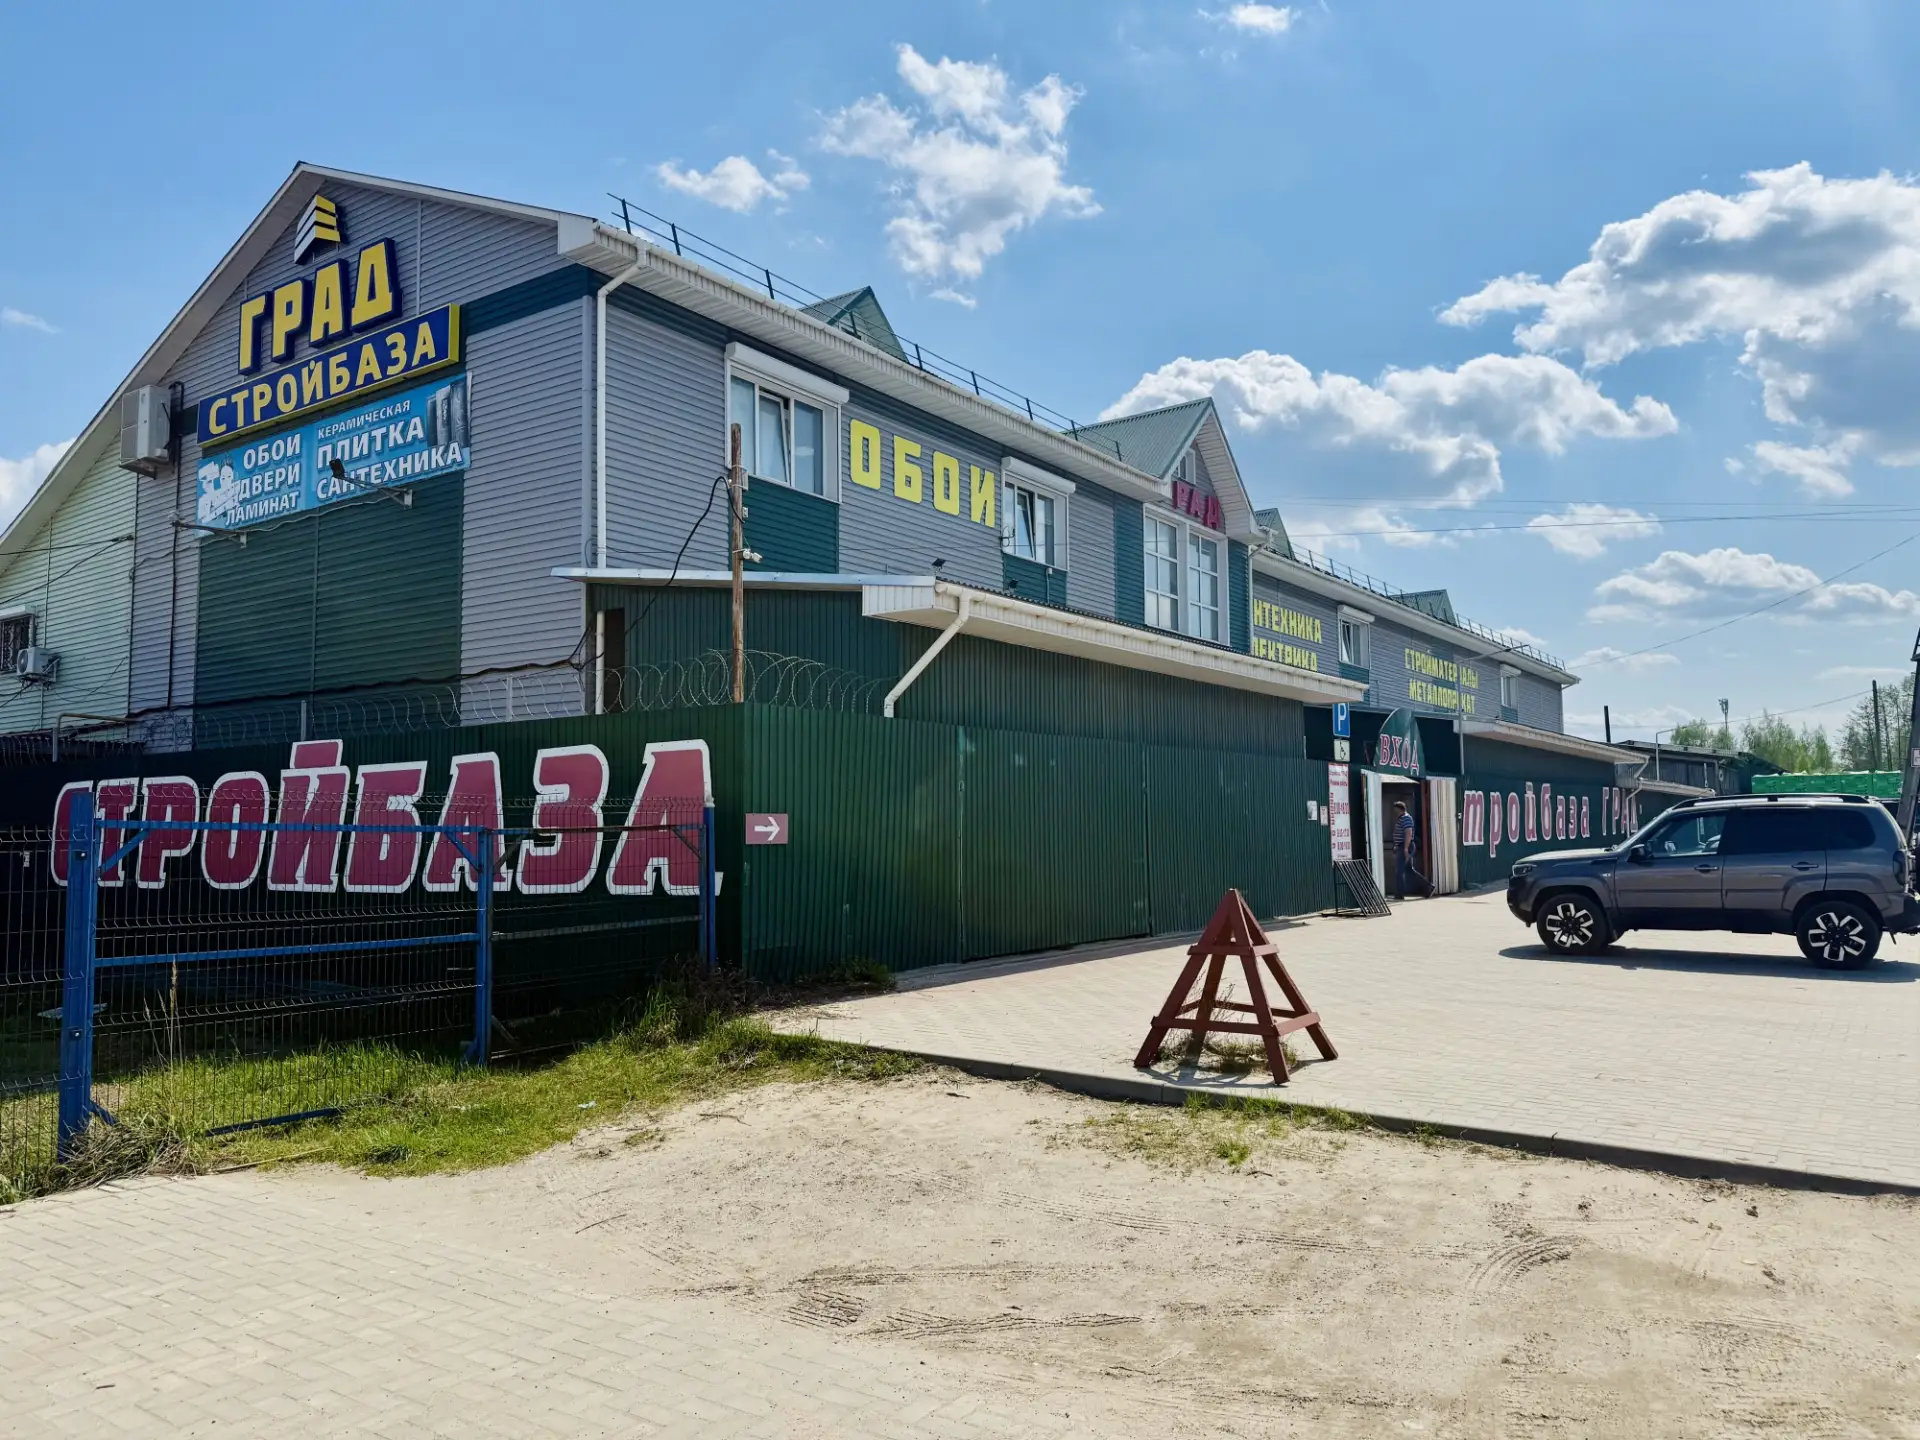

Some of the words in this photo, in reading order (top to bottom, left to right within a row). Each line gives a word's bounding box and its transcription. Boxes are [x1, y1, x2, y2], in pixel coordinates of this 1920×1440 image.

[238, 239, 401, 374] ГРАД
[208, 320, 437, 436] СТРОЙБАЗА
[317, 400, 411, 439] КЕРАМИЧЕСКАЯ
[242, 433, 301, 470] ОБОИ
[317, 416, 425, 469] ПЛИТКА
[238, 462, 300, 497] ДВЕРИ
[316, 441, 463, 500] САНТЕХНИКА
[849, 418, 996, 528] ОБОИ
[225, 490, 299, 526] ЛАМИНАТ
[1404, 647, 1479, 690] СТРОЙМАТЕРАЛЫ
[1338, 702, 1347, 732] P
[1379, 733, 1419, 777] ВХОД
[1460, 781, 1590, 858] тройбаза
